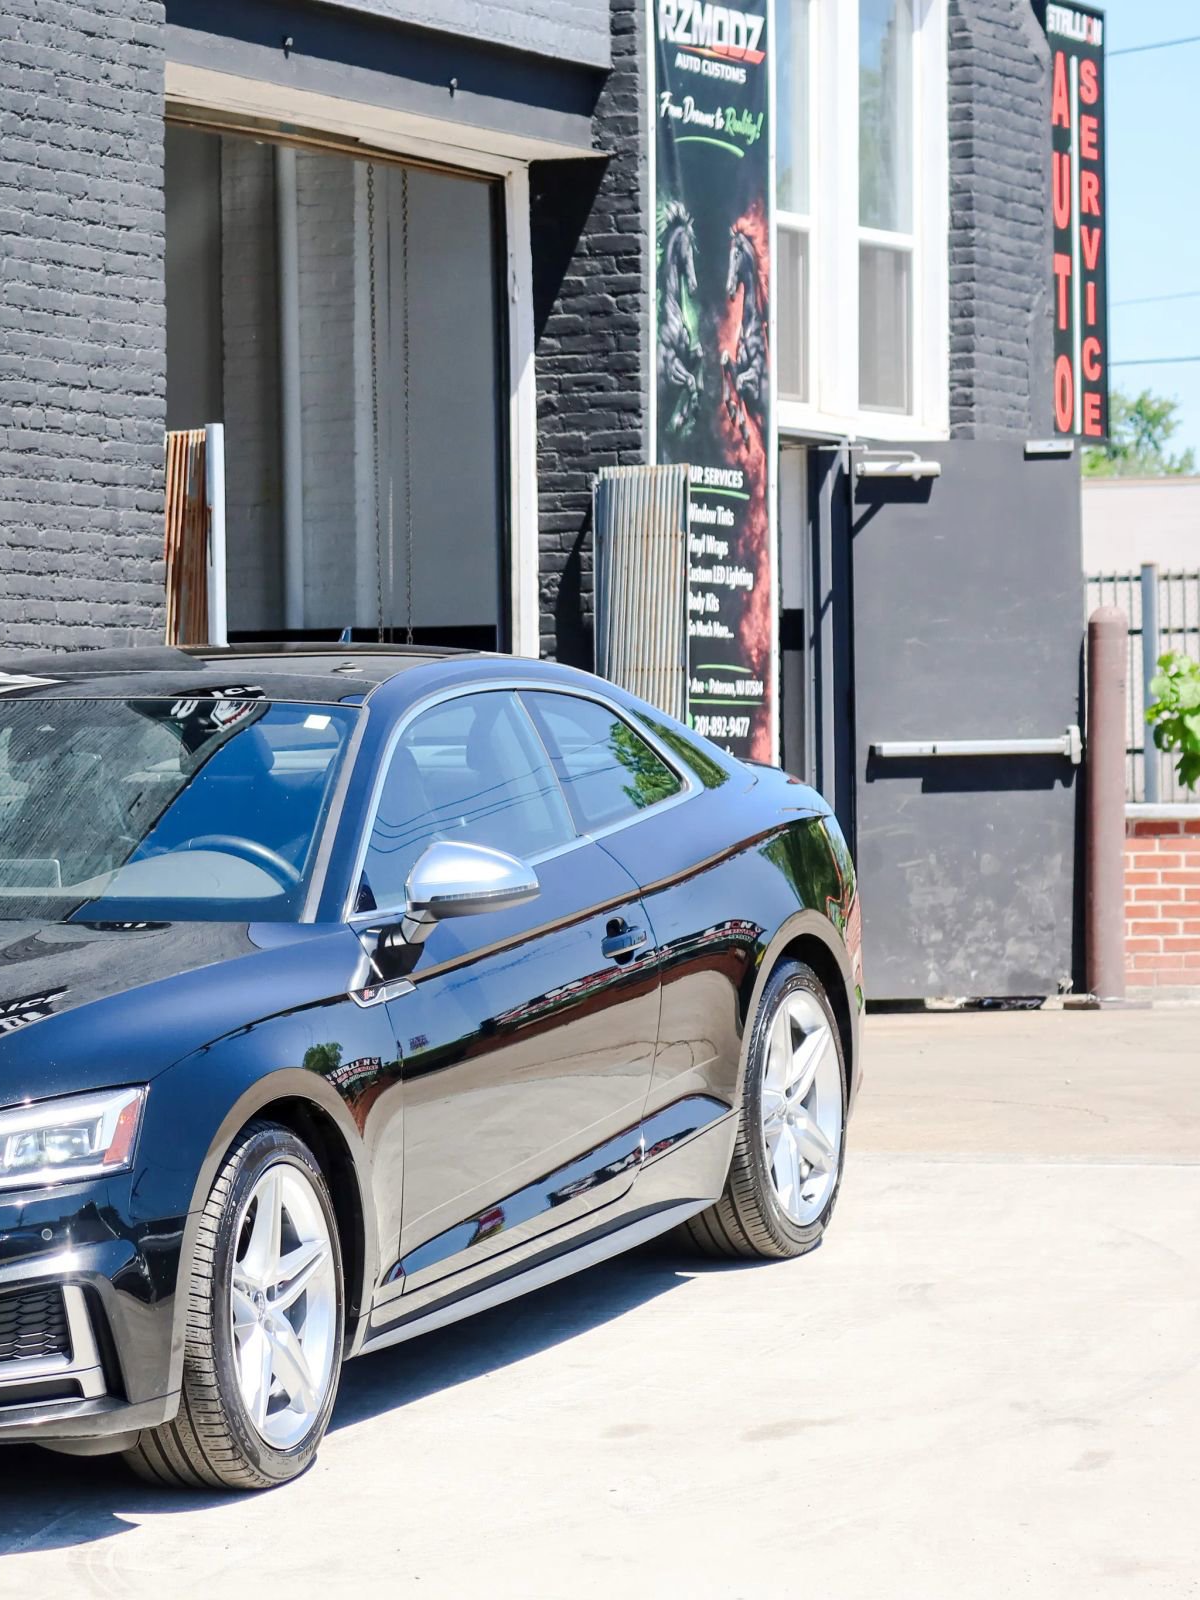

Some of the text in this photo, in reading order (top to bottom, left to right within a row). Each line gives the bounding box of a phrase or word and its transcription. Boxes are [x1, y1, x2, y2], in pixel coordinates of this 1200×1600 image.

[659, 0, 766, 64] RZMODZ
[675, 52, 747, 84] AUTO CUSTOMS
[715, 106, 725, 130] to
[1051, 51, 1074, 433] AUTO
[1079, 58, 1103, 437] SERVICE
[689, 465, 744, 489] UR SERVICES
[716, 505, 735, 526] Tints
[706, 534, 729, 560] Wraps
[712, 565, 726, 584] LED
[725, 565, 754, 591] Lighting
[705, 592, 720, 612] Kits
